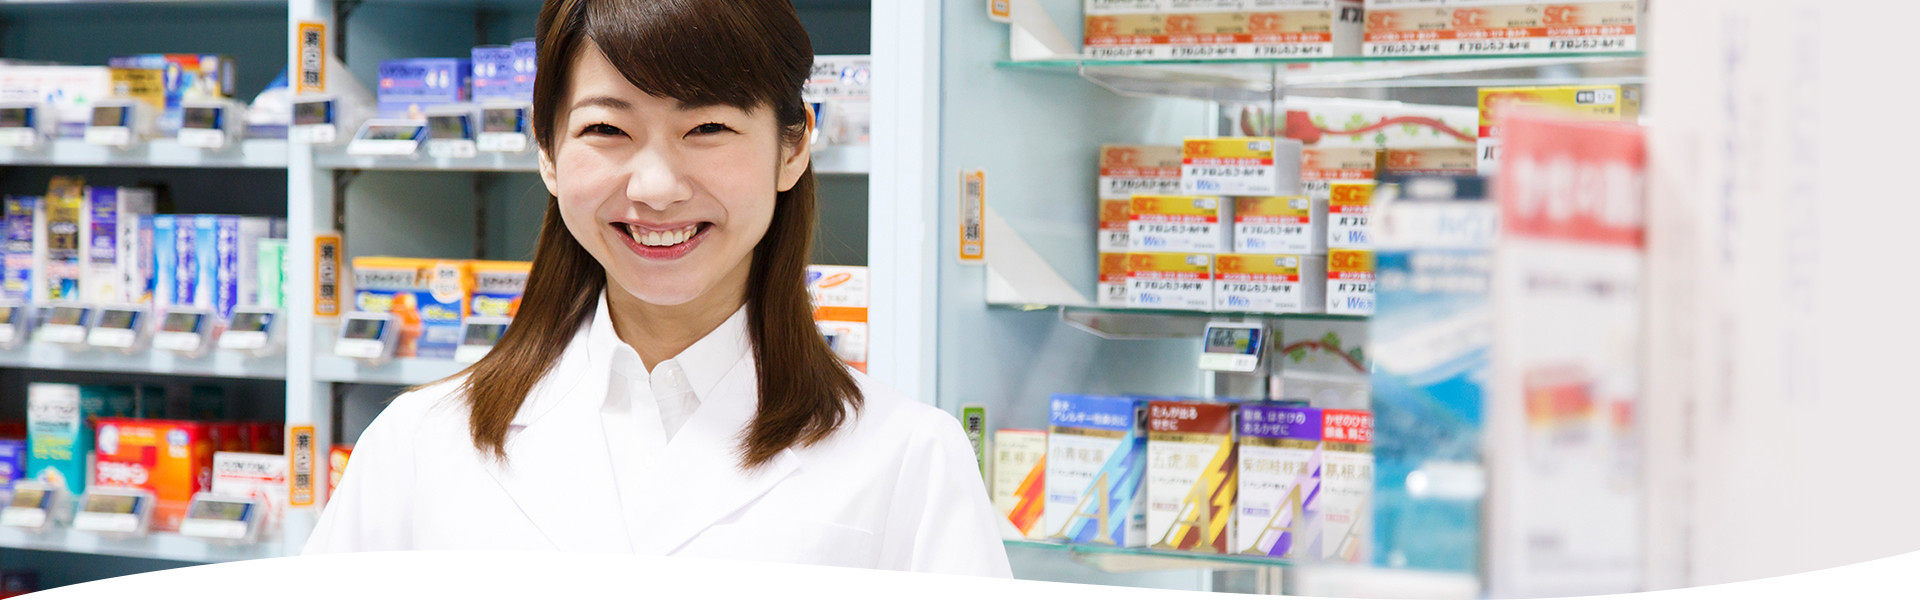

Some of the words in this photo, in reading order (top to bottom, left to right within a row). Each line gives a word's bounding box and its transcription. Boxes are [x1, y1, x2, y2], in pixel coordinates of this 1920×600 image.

[1366, 10, 1402, 31] SG
[1451, 8, 1490, 28] SG
[1542, 5, 1583, 26] SG
[1333, 185, 1366, 202] SG
[1332, 252, 1362, 268] SG
[1152, 406, 1198, 419] たんが出る
[1152, 419, 1178, 431] せきに
[1244, 423, 1289, 436] あるかぜに
